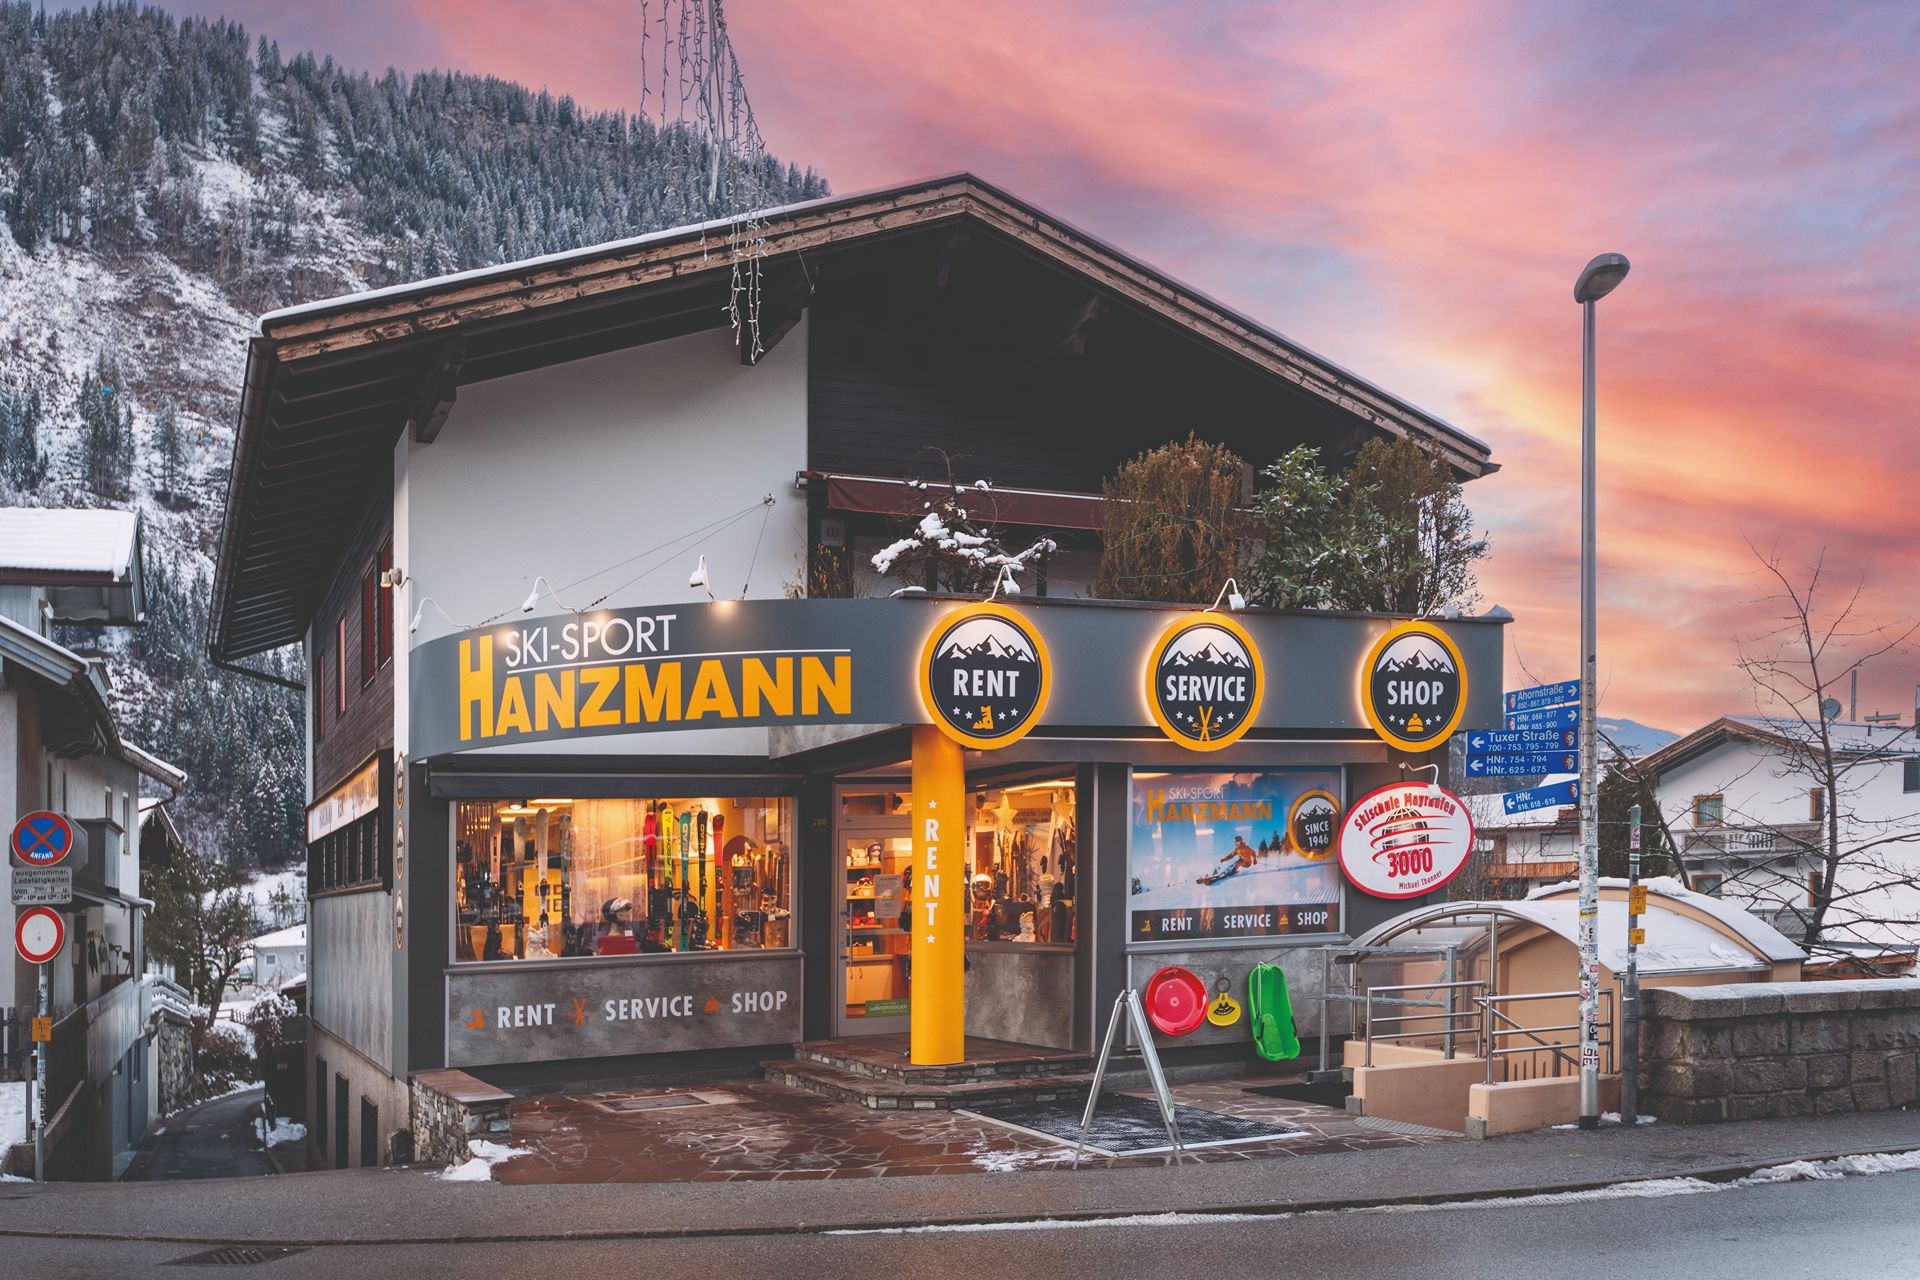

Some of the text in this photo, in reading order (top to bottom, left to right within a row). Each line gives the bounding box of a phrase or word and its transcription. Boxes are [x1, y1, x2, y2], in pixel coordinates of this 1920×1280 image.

[505, 614, 677, 668] SKI-SPORT
[458, 634, 852, 741] HANZMANN
[953, 668, 1020, 697] RENT
[1166, 674, 1245, 702] SERVICE
[1387, 680, 1444, 705] SHOP
[1517, 684, 1564, 701] Ahornstraße
[1488, 730, 1560, 743] Tuxer Straße
[1488, 744, 1502, 752] 700
[1486, 755, 1507, 764] HNr.
[1509, 755, 1524, 763] 754
[1532, 755, 1547, 763] 794
[1486, 766, 1507, 774] HNr.
[1509, 766, 1524, 774] 625
[1531, 765, 1547, 773] 675
[1169, 786, 1226, 800] SKI-SPORT
[1516, 791, 1533, 803] HNr.
[1146, 786, 1273, 823] HANZMANN
[1354, 795, 1400, 832] Skischule
[1305, 820, 1329, 835] SINCE
[1308, 836, 1329, 848] 1946
[29, 850, 54, 860] ANFANG
[1387, 847, 1433, 878] 3000
[923, 818, 940, 926] RENT
[1399, 871, 1443, 890] Michael Thanner
[1162, 911, 1328, 932] RENT SERVICE SHOP
[497, 990, 788, 1029] RENT SERVICE SHOP
